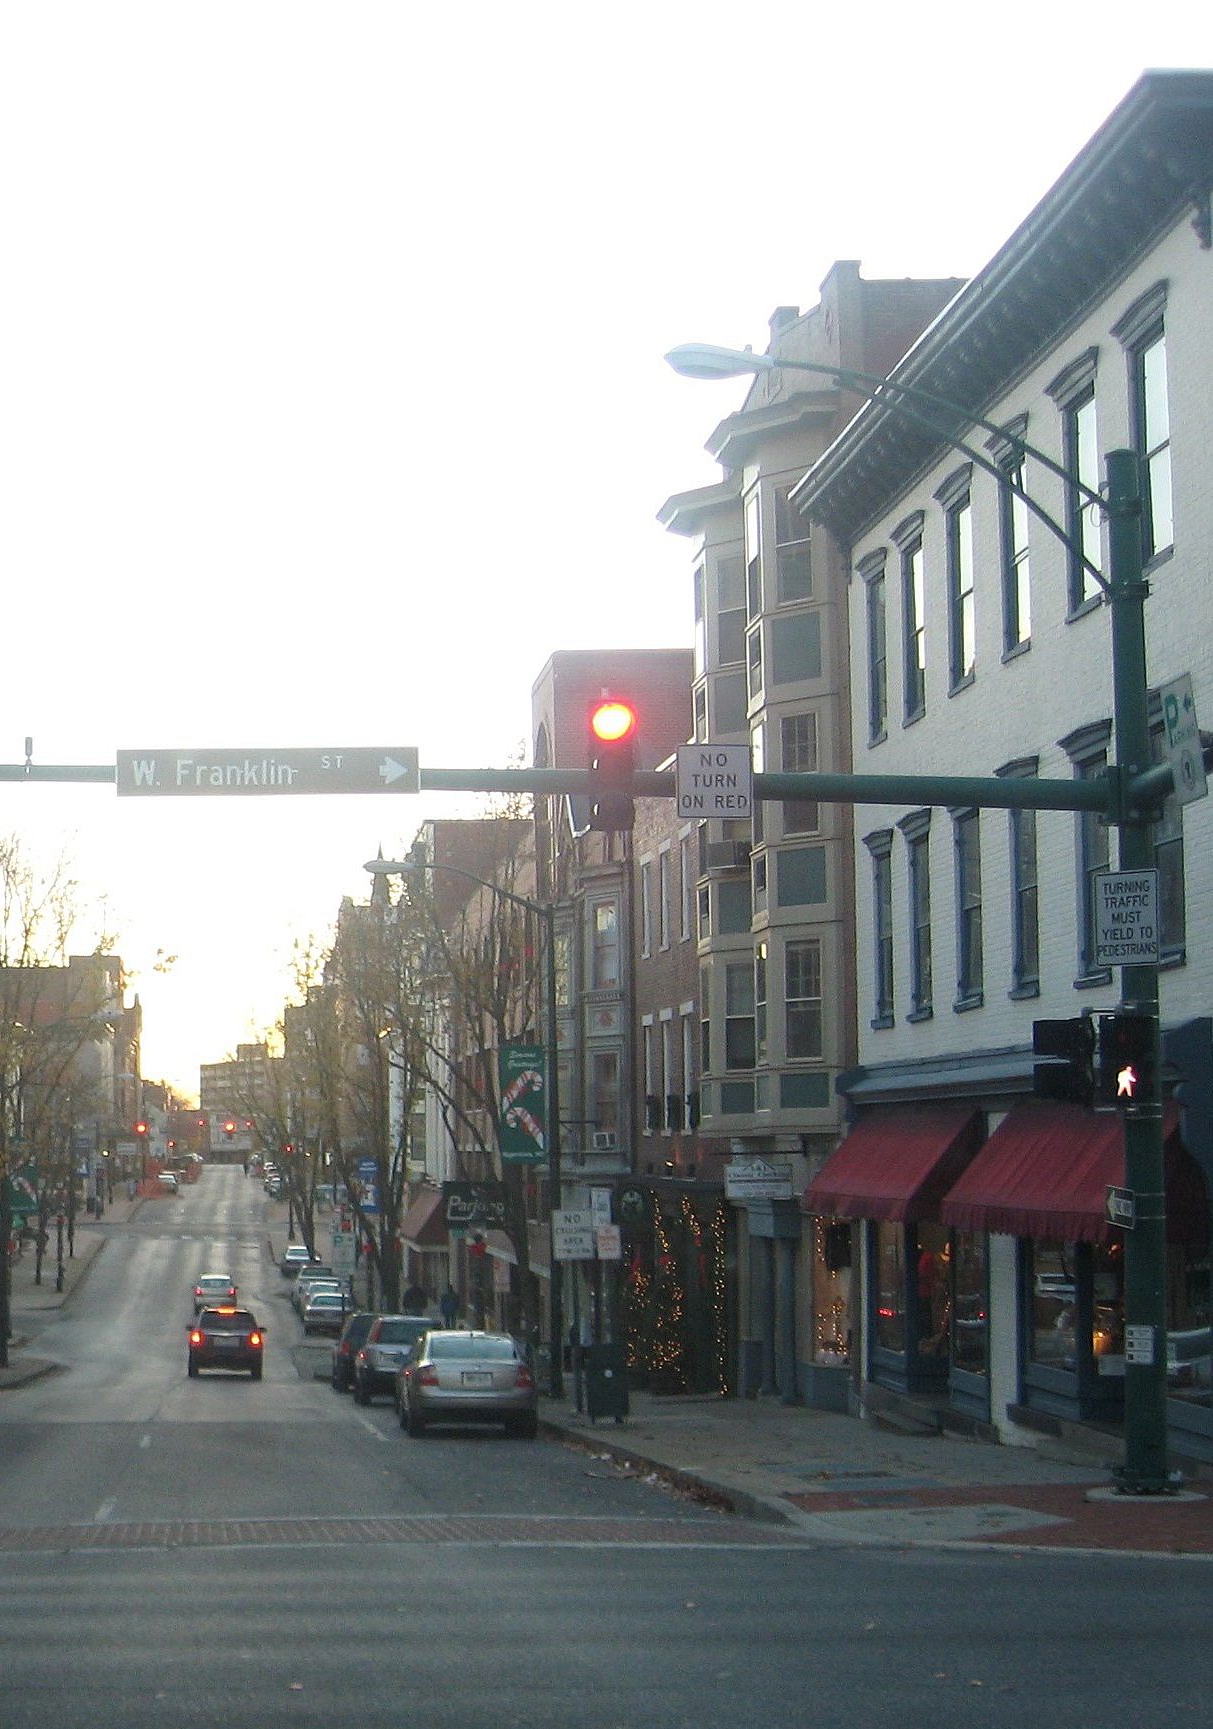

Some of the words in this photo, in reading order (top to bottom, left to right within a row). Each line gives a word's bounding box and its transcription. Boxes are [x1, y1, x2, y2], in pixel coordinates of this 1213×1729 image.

[700, 752, 727, 766] NO
[132, 759, 161, 786] W.
[176, 759, 297, 786] Franklin
[321, 755, 344, 769] ST
[692, 774, 737, 787] TURN
[681, 794, 704, 808] ON
[715, 794, 747, 808] RED
[1103, 879, 1150, 896] TURNING
[1103, 894, 1149, 909] TRAFFIC
[1111, 911, 1142, 924] MUST
[1102, 927, 1134, 941] YIELD
[1139, 926, 1153, 939] TO
[1096, 942, 1157, 957] PEDESTRIANS
[564, 1213, 581, 1224] NO
